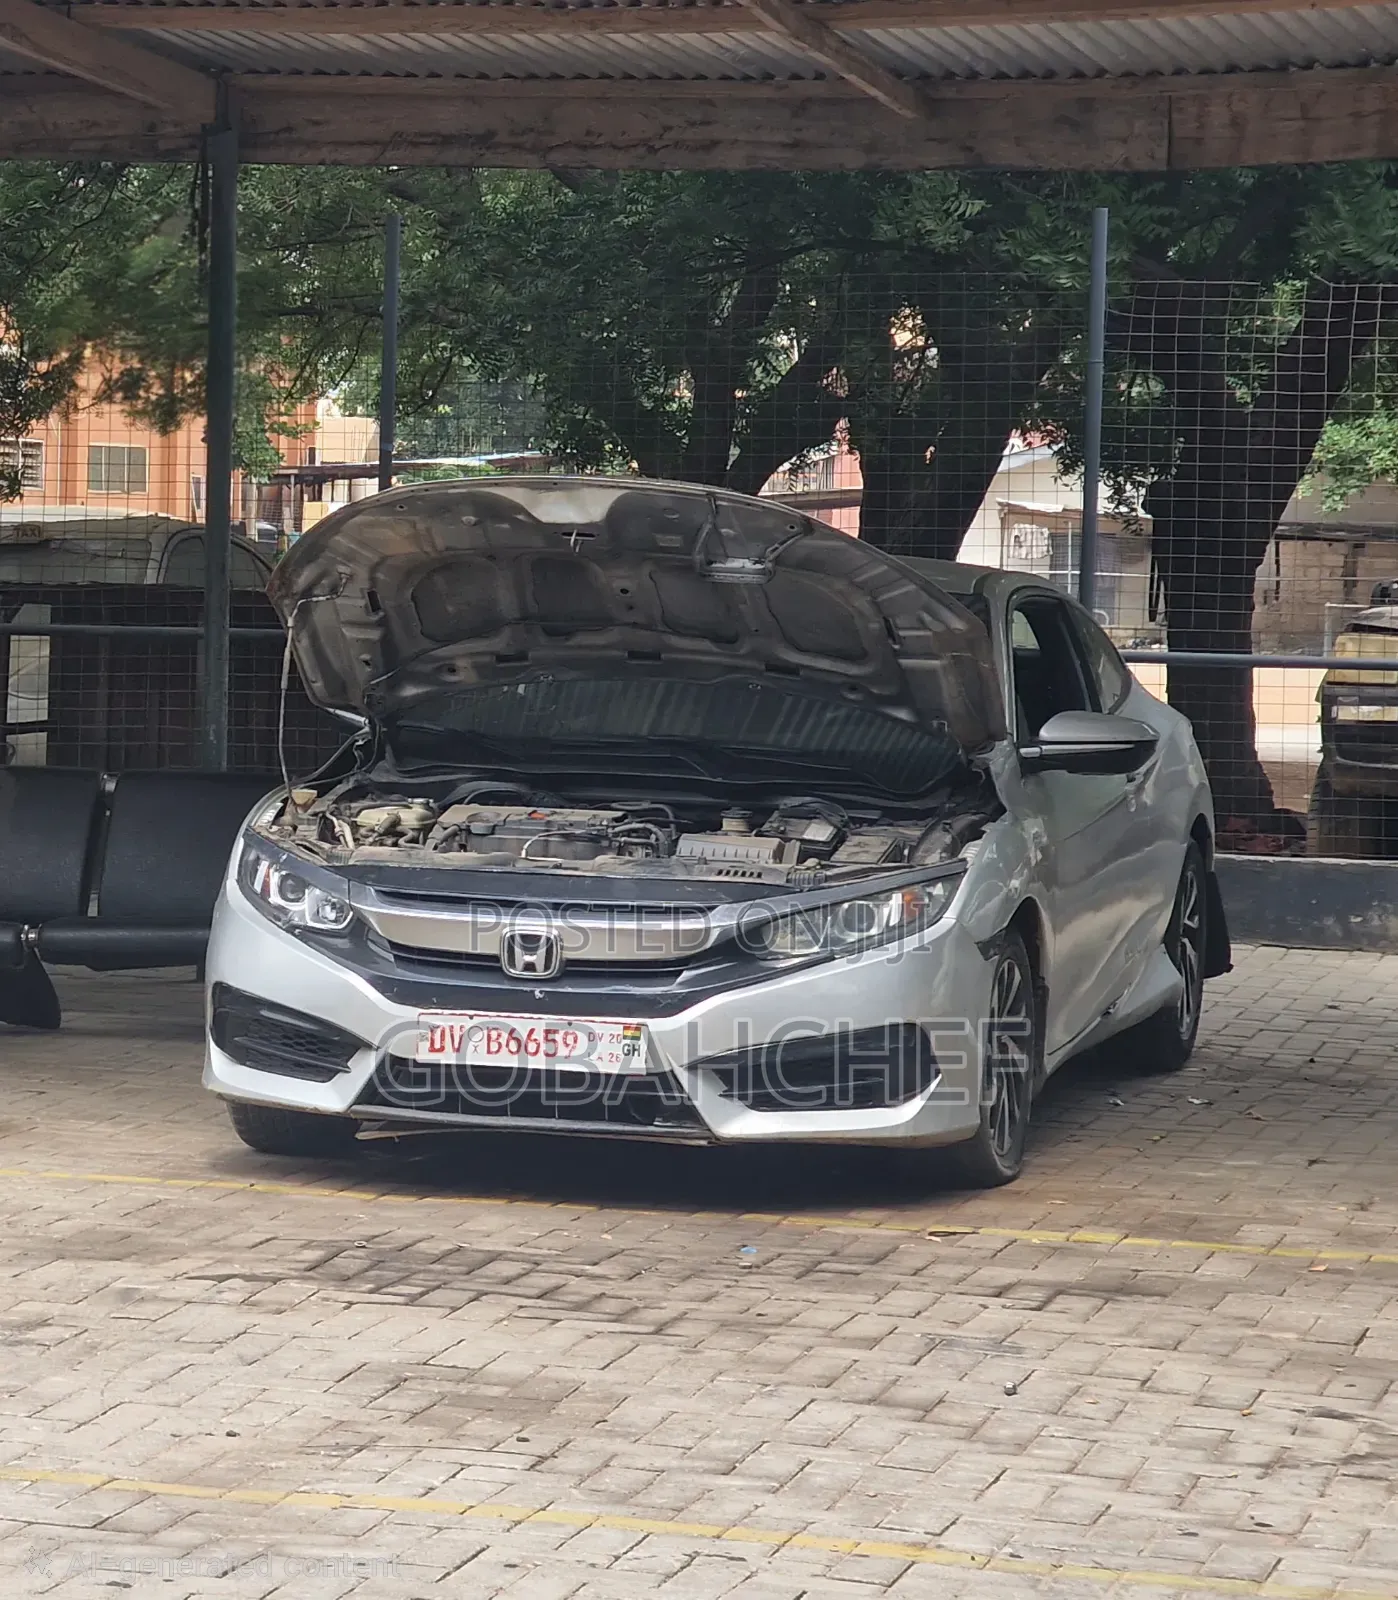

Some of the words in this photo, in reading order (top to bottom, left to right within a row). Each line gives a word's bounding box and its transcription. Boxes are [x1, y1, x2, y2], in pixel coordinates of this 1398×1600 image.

[428, 1024, 465, 1053] DV
[486, 1026, 579, 1060] B6659
[622, 1043, 641, 1057] GH
